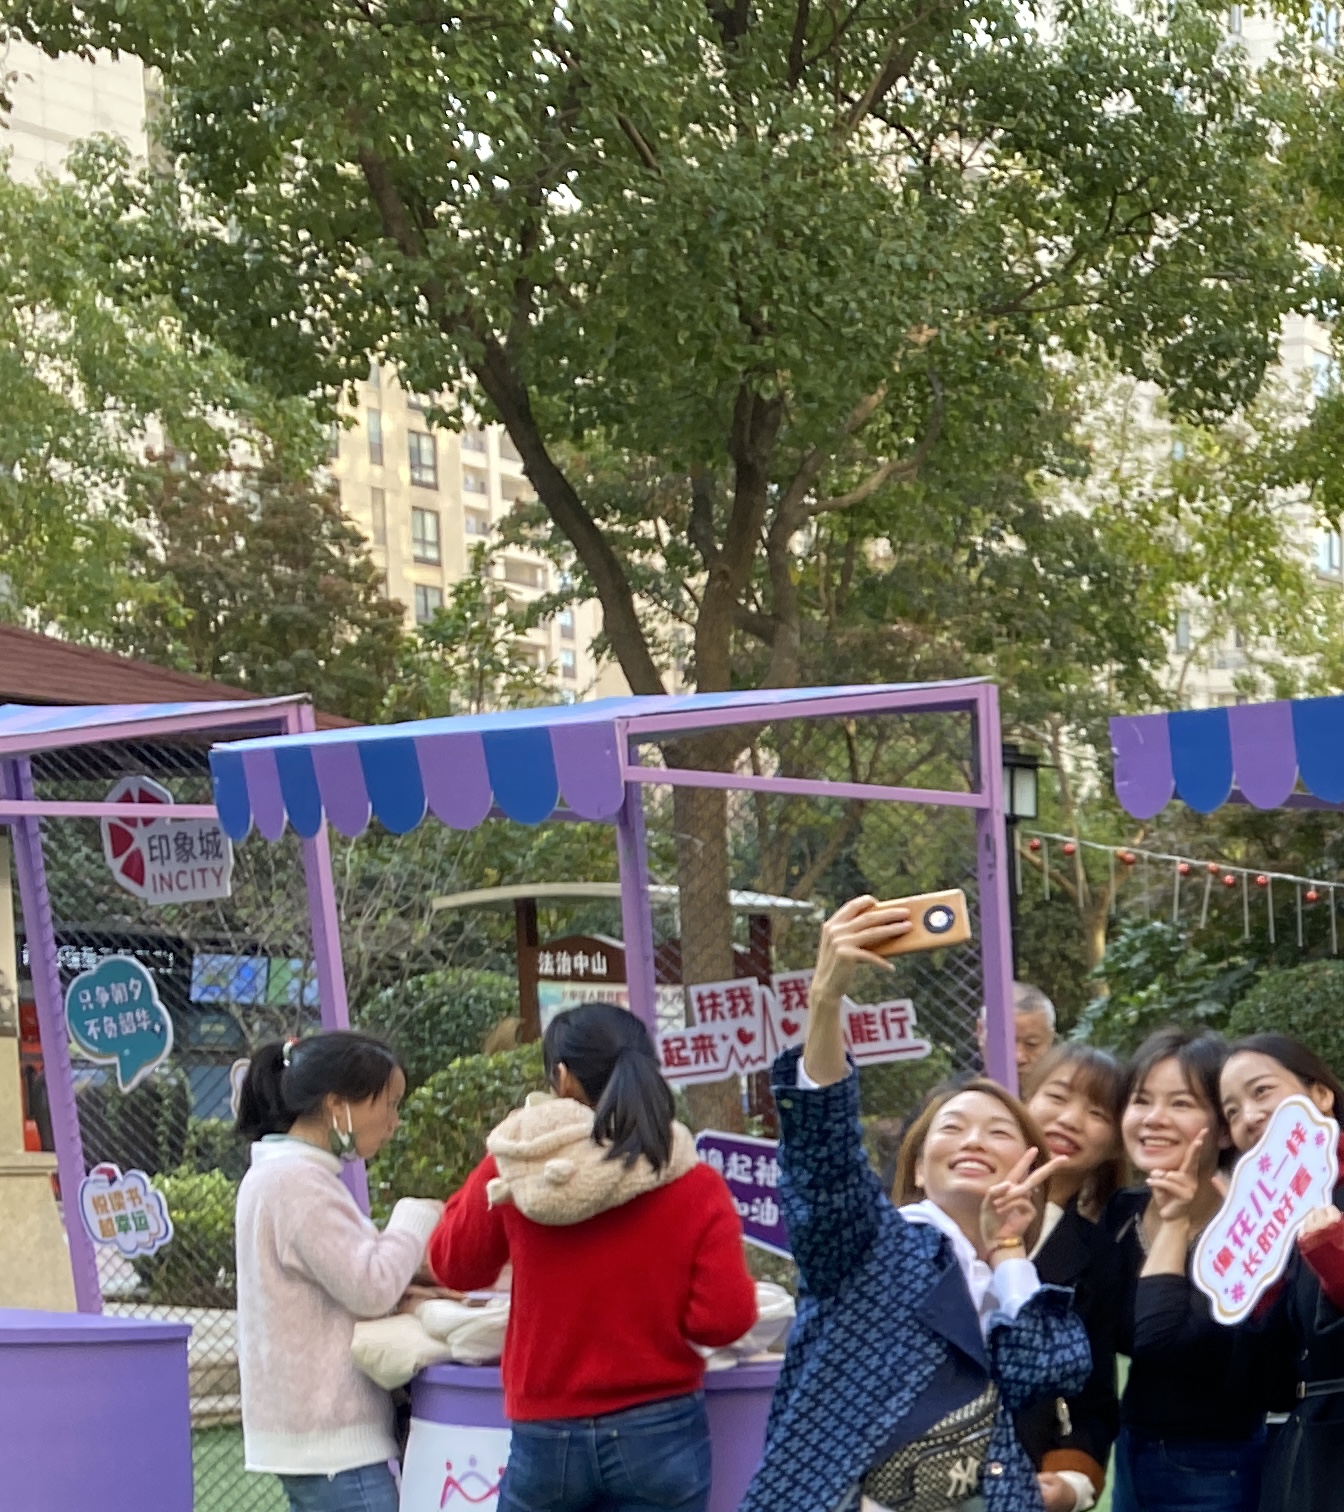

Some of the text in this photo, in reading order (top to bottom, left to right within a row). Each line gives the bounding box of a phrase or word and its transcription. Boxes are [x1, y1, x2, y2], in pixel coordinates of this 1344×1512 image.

[147, 826, 224, 867] 印象城
[151, 867, 225, 894] INCITY
[538, 950, 608, 977] 法治中山
[78, 977, 142, 1011] 只争朝夕
[695, 985, 756, 1023] 扶我
[778, 976, 815, 1012] 我
[84, 1008, 152, 1040] 不负韶华
[847, 1006, 910, 1045] 能行
[661, 1033, 718, 1068] 起来
